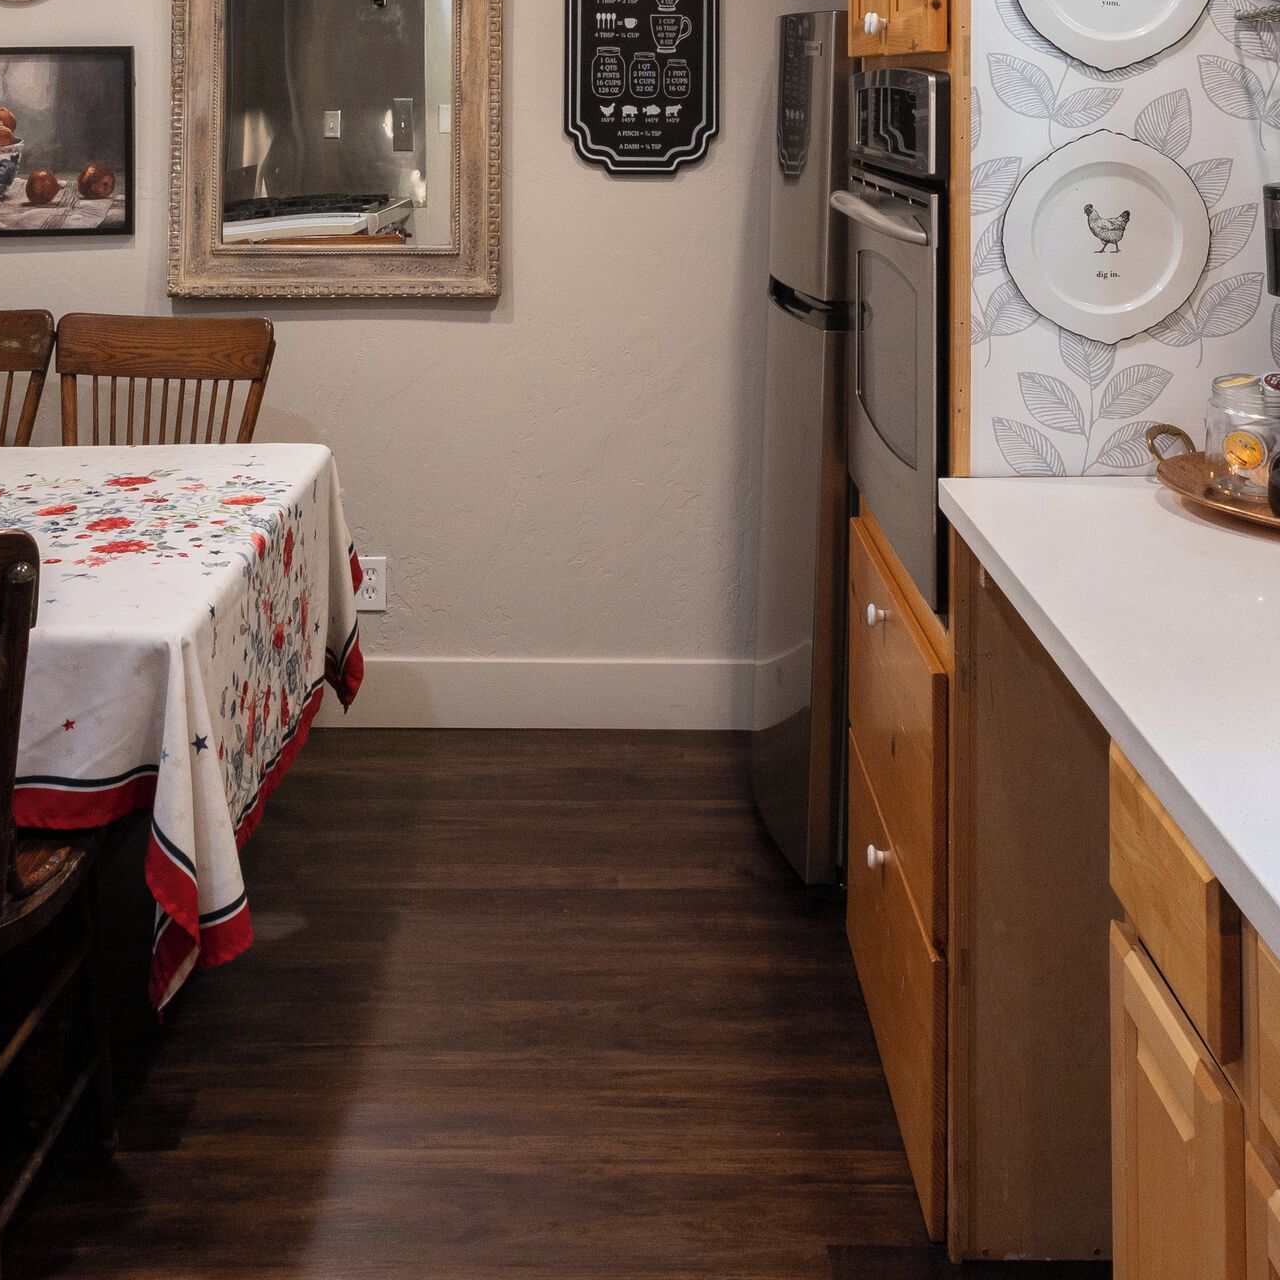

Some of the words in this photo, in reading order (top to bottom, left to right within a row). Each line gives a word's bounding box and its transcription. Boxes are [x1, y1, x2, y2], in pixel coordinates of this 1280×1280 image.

[1101, 0, 1121, 8] yum.
[1096, 270, 1108, 280] dig
[1110, 270, 1120, 278] in.
